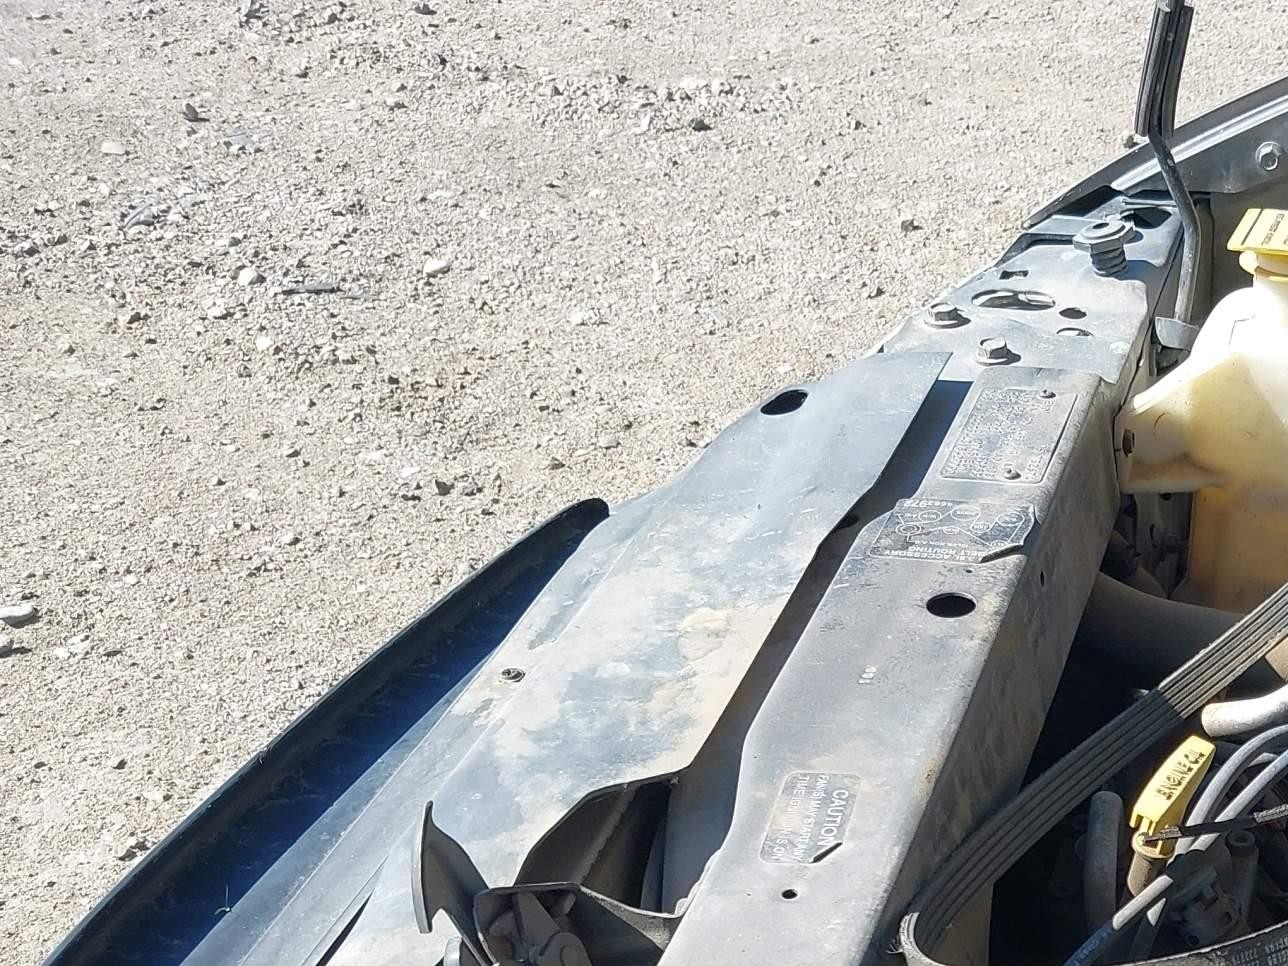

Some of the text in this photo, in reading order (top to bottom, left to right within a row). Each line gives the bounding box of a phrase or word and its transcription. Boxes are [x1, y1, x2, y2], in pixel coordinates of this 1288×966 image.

[884, 550, 951, 560] ACCESSORY
[908, 546, 956, 554] ROUTING
[794, 775, 809, 794] TIME
[1156, 762, 1193, 801] ENGINE
[807, 800, 821, 816] MAY
[816, 789, 849, 845] CAUTION
[798, 817, 816, 843] START
[771, 846, 785, 859] ON
[792, 843, 806, 861] ANY
